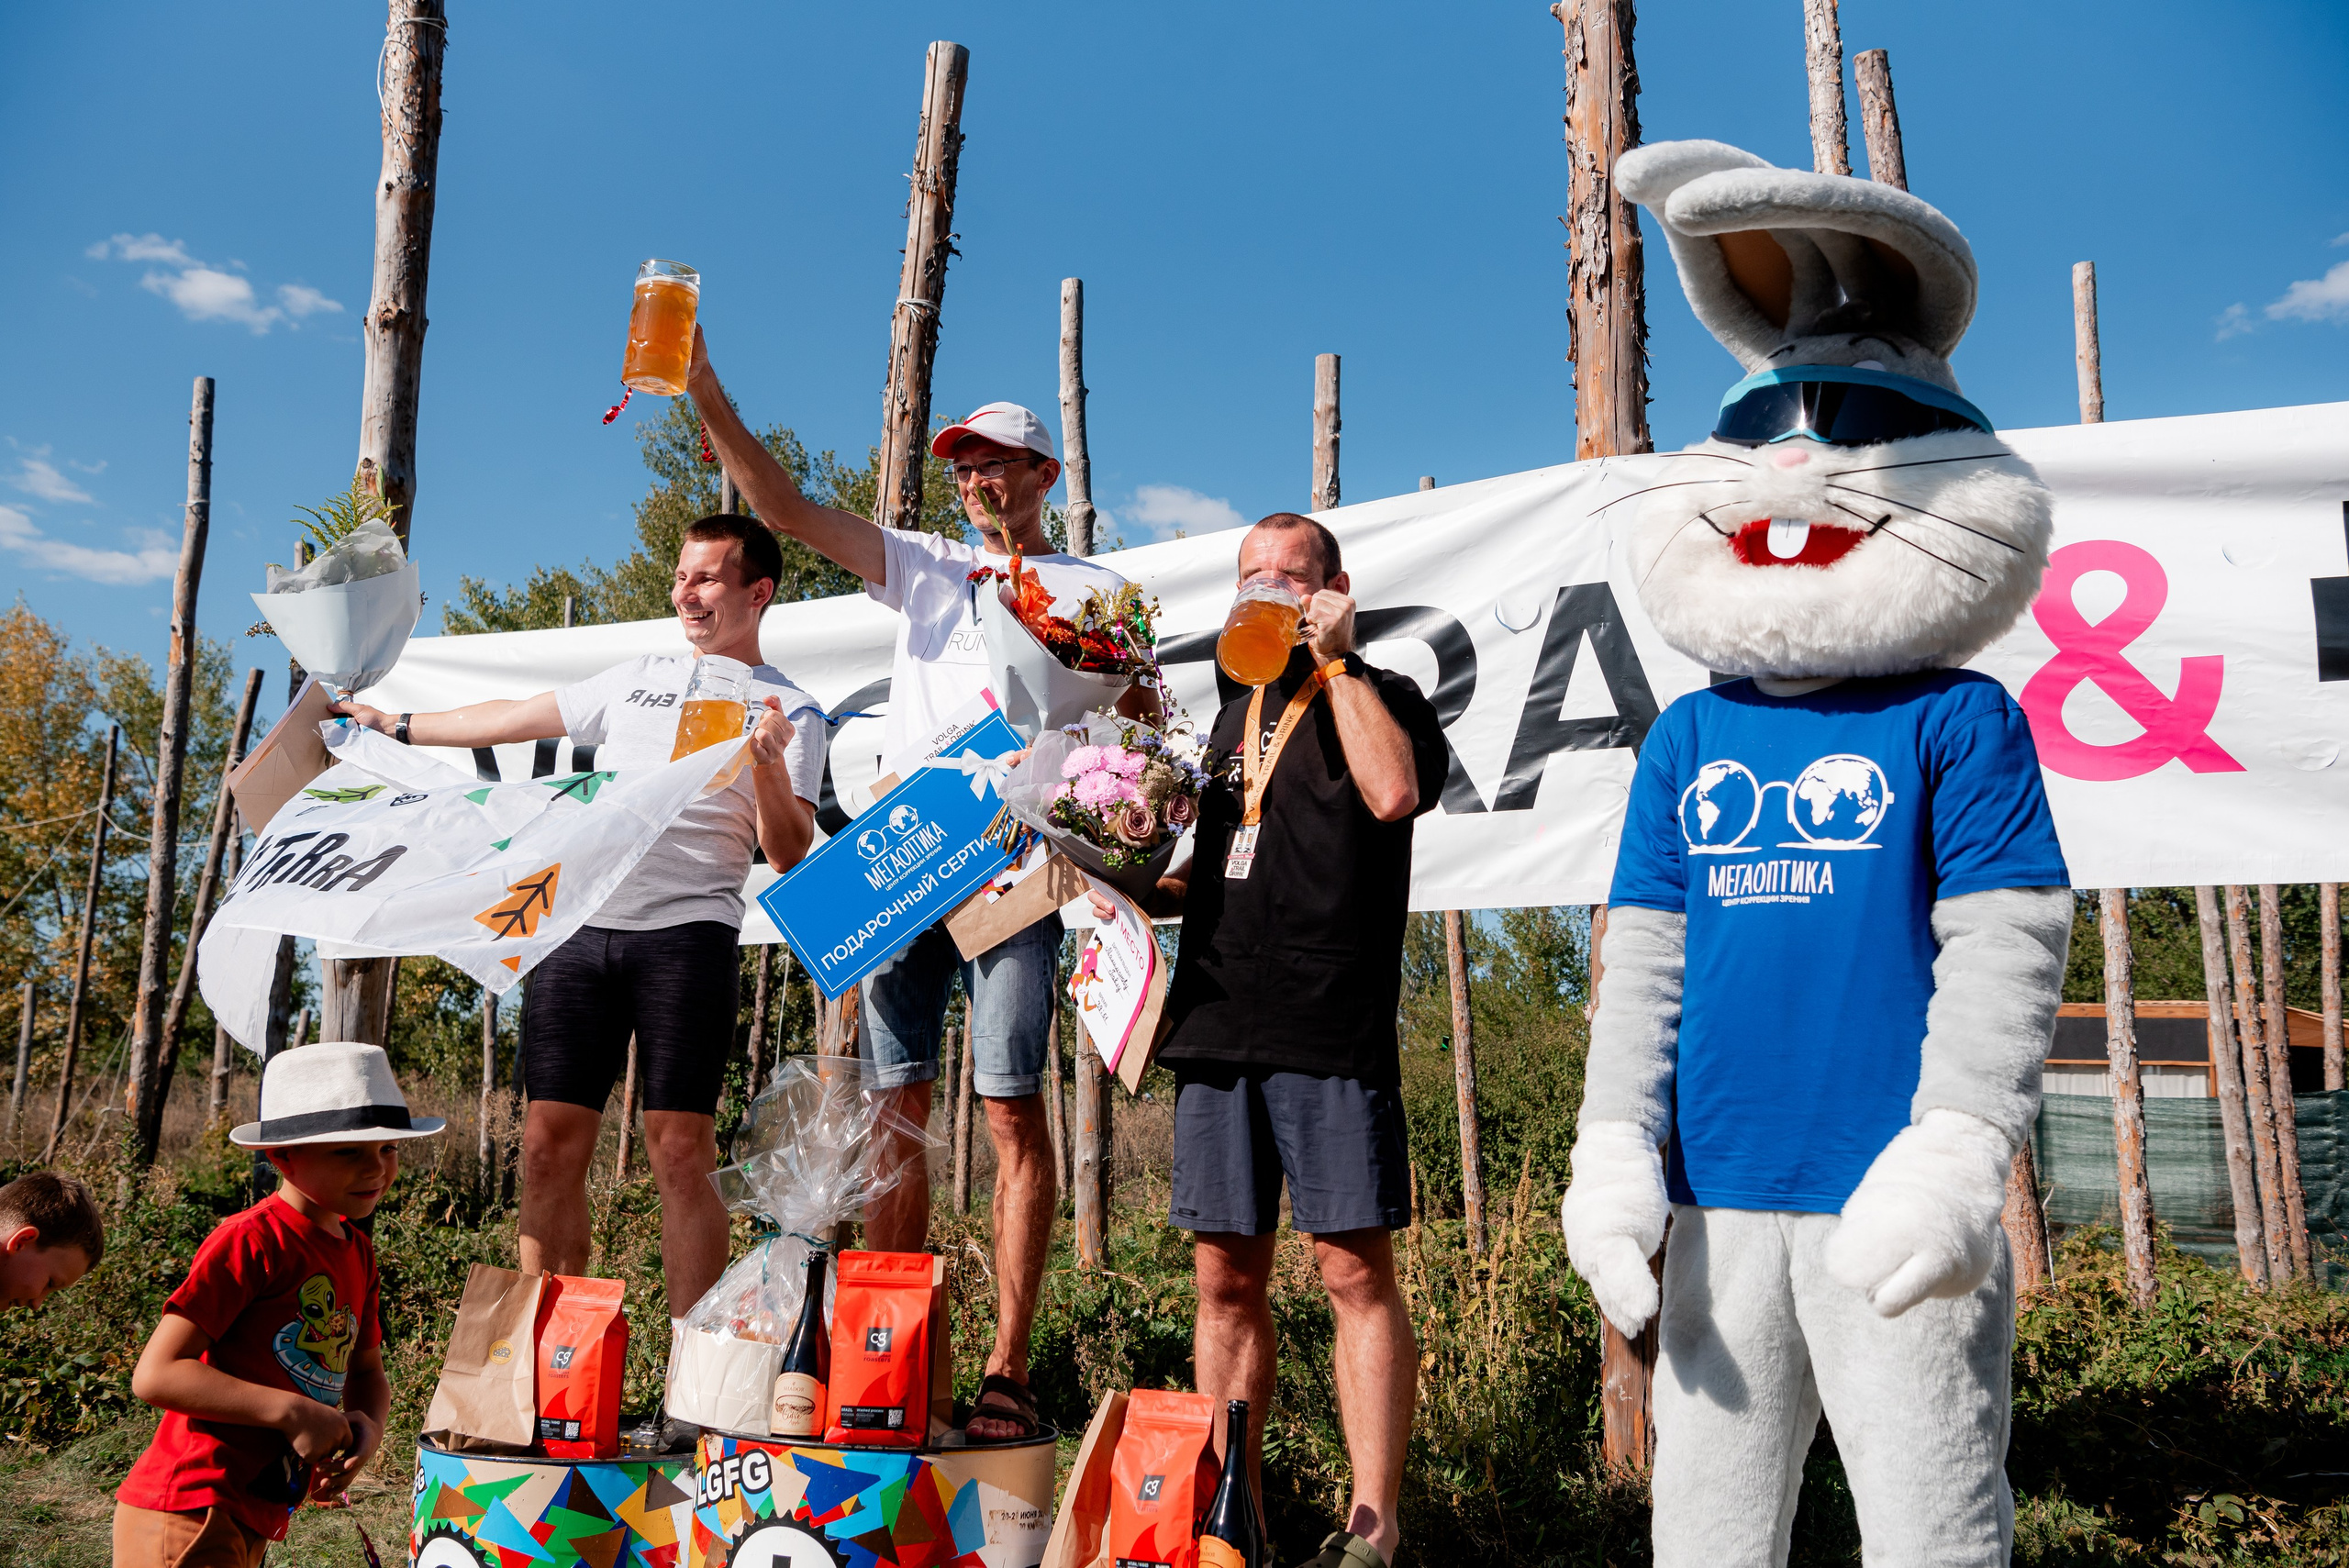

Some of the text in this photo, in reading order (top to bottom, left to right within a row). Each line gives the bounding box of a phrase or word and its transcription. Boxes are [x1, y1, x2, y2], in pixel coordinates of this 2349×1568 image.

[2019, 539, 2247, 782] &
[931, 724, 960, 745] VOLGA
[1248, 779, 1265, 813] VOLGA
[1261, 750, 1277, 780] TRAIL
[1276, 713, 1297, 741] DRINK
[863, 820, 948, 892] МЕГАОПТИКА
[1708, 860, 1834, 897] МЕГАОПТИКА
[1779, 895, 1810, 904] ЗРЕНИЯ
[820, 872, 940, 971] ПОДАРОЧНЫЙ
[1119, 920, 1145, 971] МЕСТО
[556, 1351, 572, 1365] cg
[870, 1332, 887, 1347] cg
[693, 1451, 771, 1509] LGFG
[1145, 1480, 1160, 1496] cg
